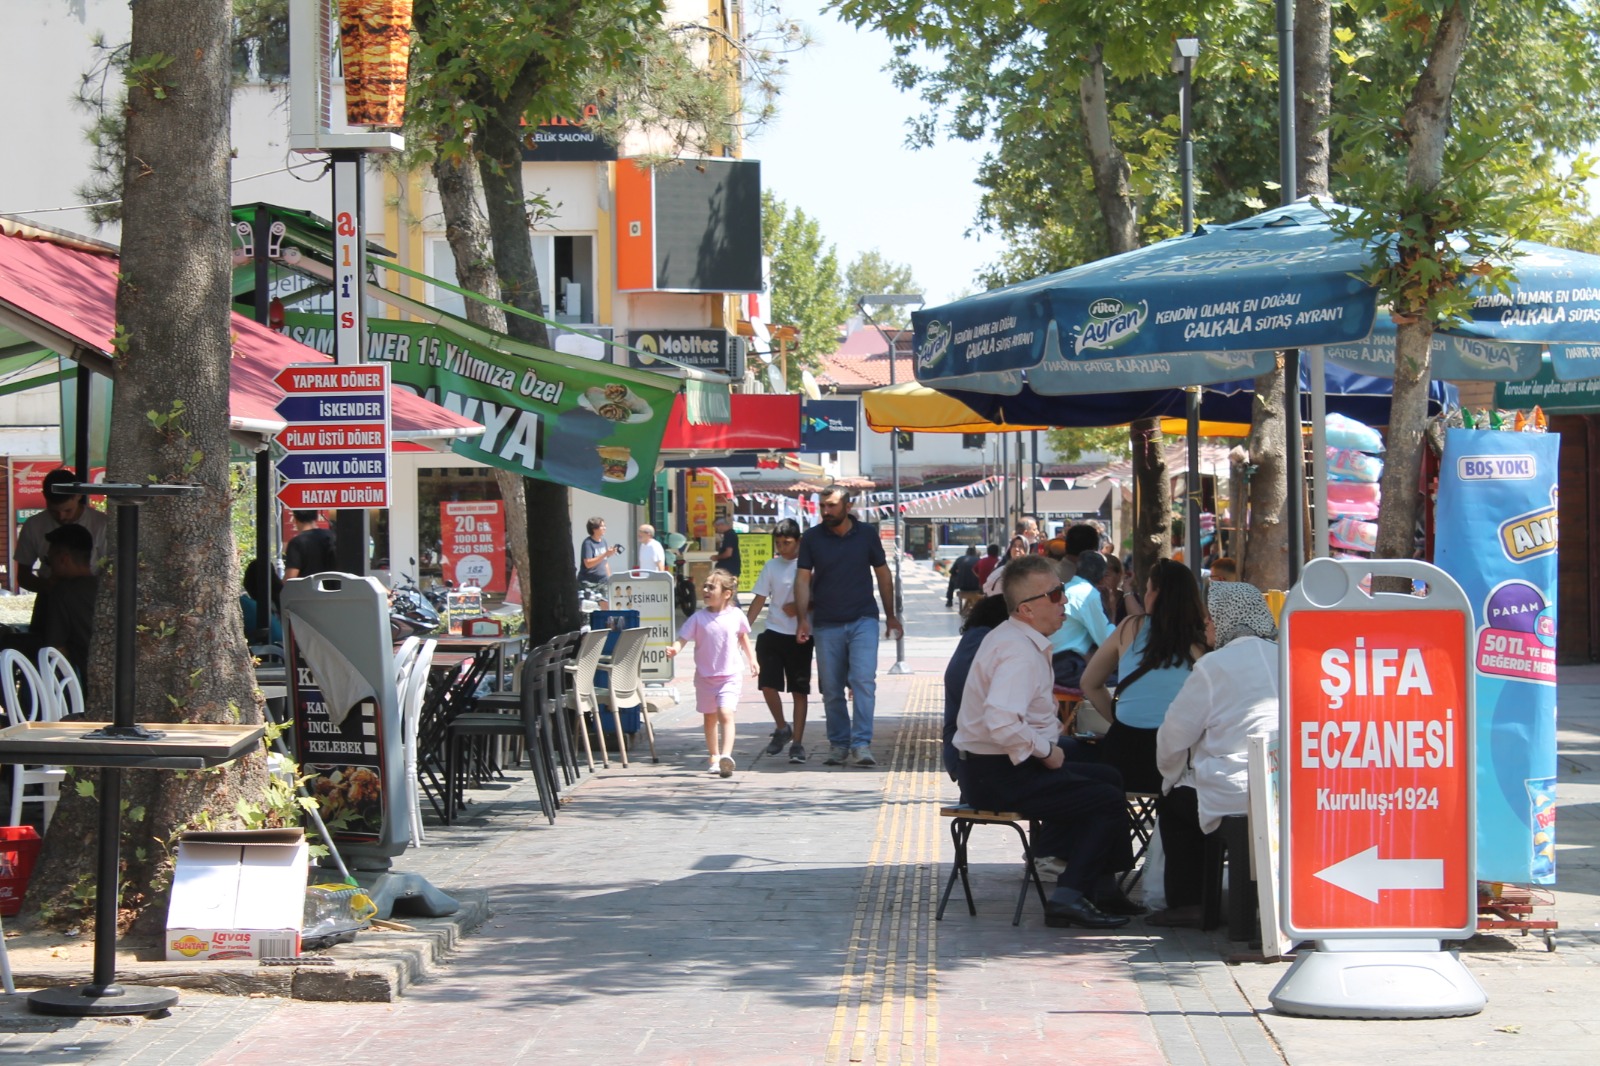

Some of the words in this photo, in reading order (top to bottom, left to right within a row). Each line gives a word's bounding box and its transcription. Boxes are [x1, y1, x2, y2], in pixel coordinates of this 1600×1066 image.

[558, 133, 594, 142] SALONU
[1517, 290, 1554, 305] OLMAK
[1555, 289, 1570, 304] EN
[1092, 302, 1121, 315] sütaş
[1155, 305, 1198, 324] KENDİN
[1200, 300, 1241, 319] OLMAK
[1242, 298, 1260, 314] EN
[1500, 306, 1566, 328] ÇALKALA
[1082, 309, 1139, 347] Ayran
[1184, 314, 1253, 342] ÇALKALA
[1254, 314, 1293, 330] SÜTAŞ
[1295, 306, 1344, 326] AYRAN'I
[679, 355, 699, 364] Teknik
[700, 356, 719, 364] Servis
[293, 374, 338, 389] YAPRAK
[341, 371, 381, 388] DÖNER
[520, 367, 564, 405] Özel
[320, 400, 381, 417] İSKENDER
[286, 430, 316, 446] PİLAV
[318, 429, 345, 446] ÜSTÜ
[347, 429, 382, 446] DÖNER
[302, 460, 340, 475] TAVUK
[342, 458, 382, 475] DÖNER
[1465, 461, 1493, 479] BOŞ
[1495, 460, 1529, 475] YOK!
[302, 490, 337, 503] HATAY
[341, 487, 384, 503] DÜRÜM
[454, 515, 475, 533] 20
[454, 534, 477, 544] 1000
[479, 534, 493, 543] DK
[453, 545, 472, 554] 250
[473, 544, 494, 554] SMS
[629, 592, 669, 604] VESİKALIK
[1492, 602, 1539, 618] PARAM
[1484, 634, 1507, 652] 50
[1509, 637, 1525, 656] TL
[1481, 654, 1532, 673] DEĞERDE
[1319, 637, 1434, 710] ŞİFA
[309, 740, 363, 755] KELEBEK
[1300, 709, 1455, 769] ECZANESİ
[1316, 786, 1439, 817] Kuruluş:1924
[173, 941, 207, 951] SUNTAT
[211, 932, 252, 944] Lavaş
